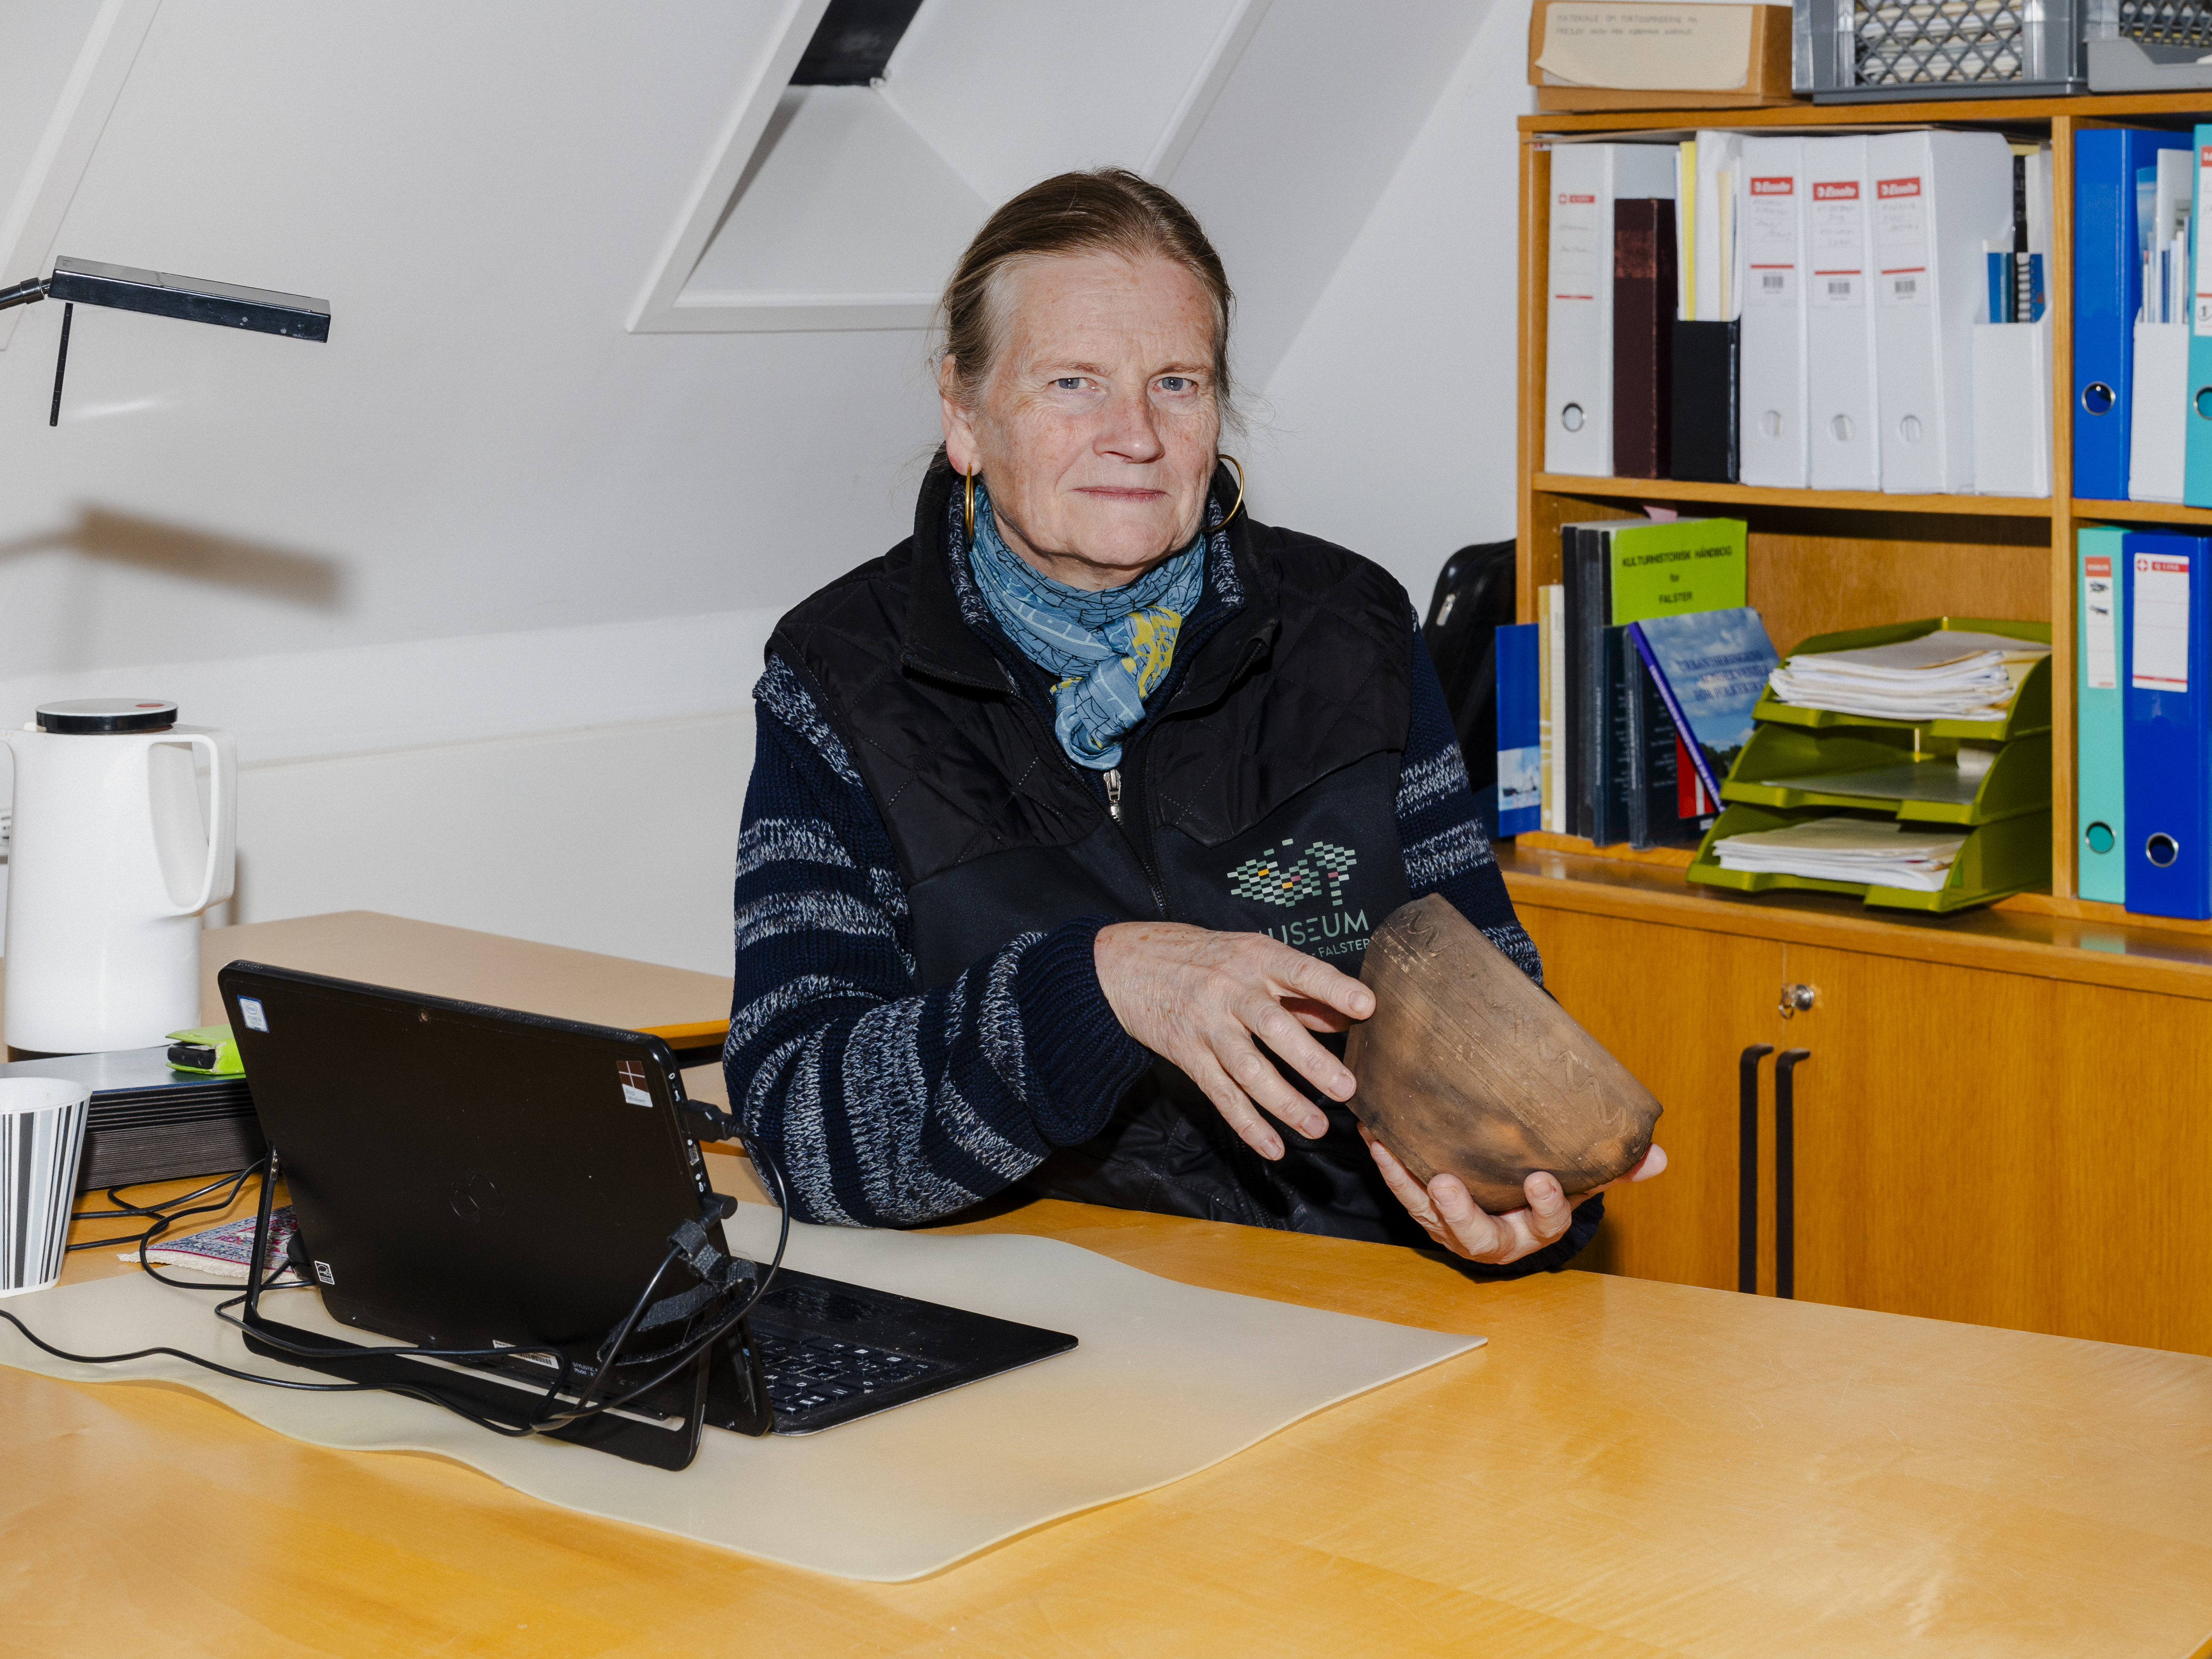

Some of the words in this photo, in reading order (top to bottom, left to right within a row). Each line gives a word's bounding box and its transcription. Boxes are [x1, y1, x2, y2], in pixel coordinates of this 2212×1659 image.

[1622, 550, 1692, 567] KULTURHISTORISK
[1694, 545, 1733, 559] HÅNDBOG
[1669, 573, 1679, 582] for
[1658, 591, 1693, 604] FALSTER
[1259, 909, 1369, 945] USEUM
